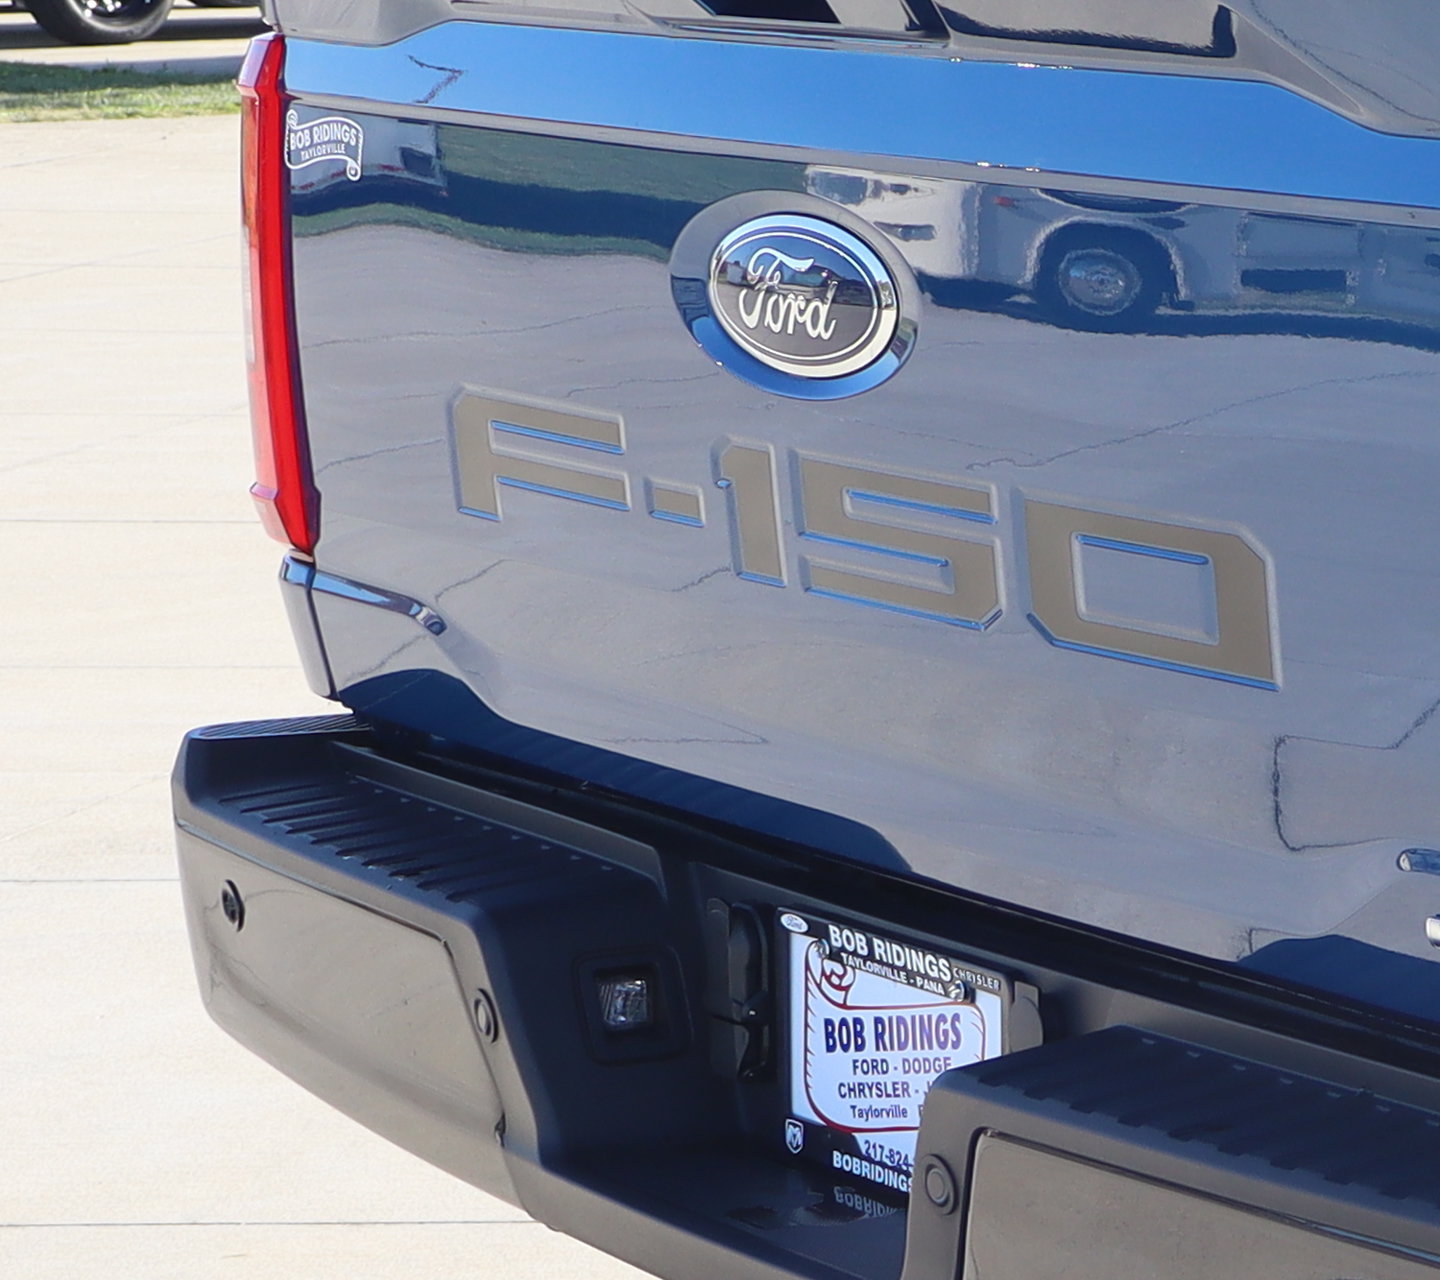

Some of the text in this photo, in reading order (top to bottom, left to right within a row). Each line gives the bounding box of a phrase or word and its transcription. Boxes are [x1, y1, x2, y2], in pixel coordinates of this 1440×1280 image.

[290, 122, 358, 151] BOB RIDINGS
[301, 143, 346, 161] TAYLORVILLE
[738, 247, 839, 340] Ford
[449, 384, 1284, 693] F-150
[828, 924, 952, 982] BOB RIDINGS
[840, 951, 946, 996] TAYLORVILLE PANA
[952, 967, 1001, 992] CHRYSLER
[823, 1012, 963, 1054] BOB RIDINGS
[852, 1056, 952, 1076] FORD DODGE
[838, 1081, 912, 1099] CHRYSLER
[849, 1103, 908, 1122] Taylorville
